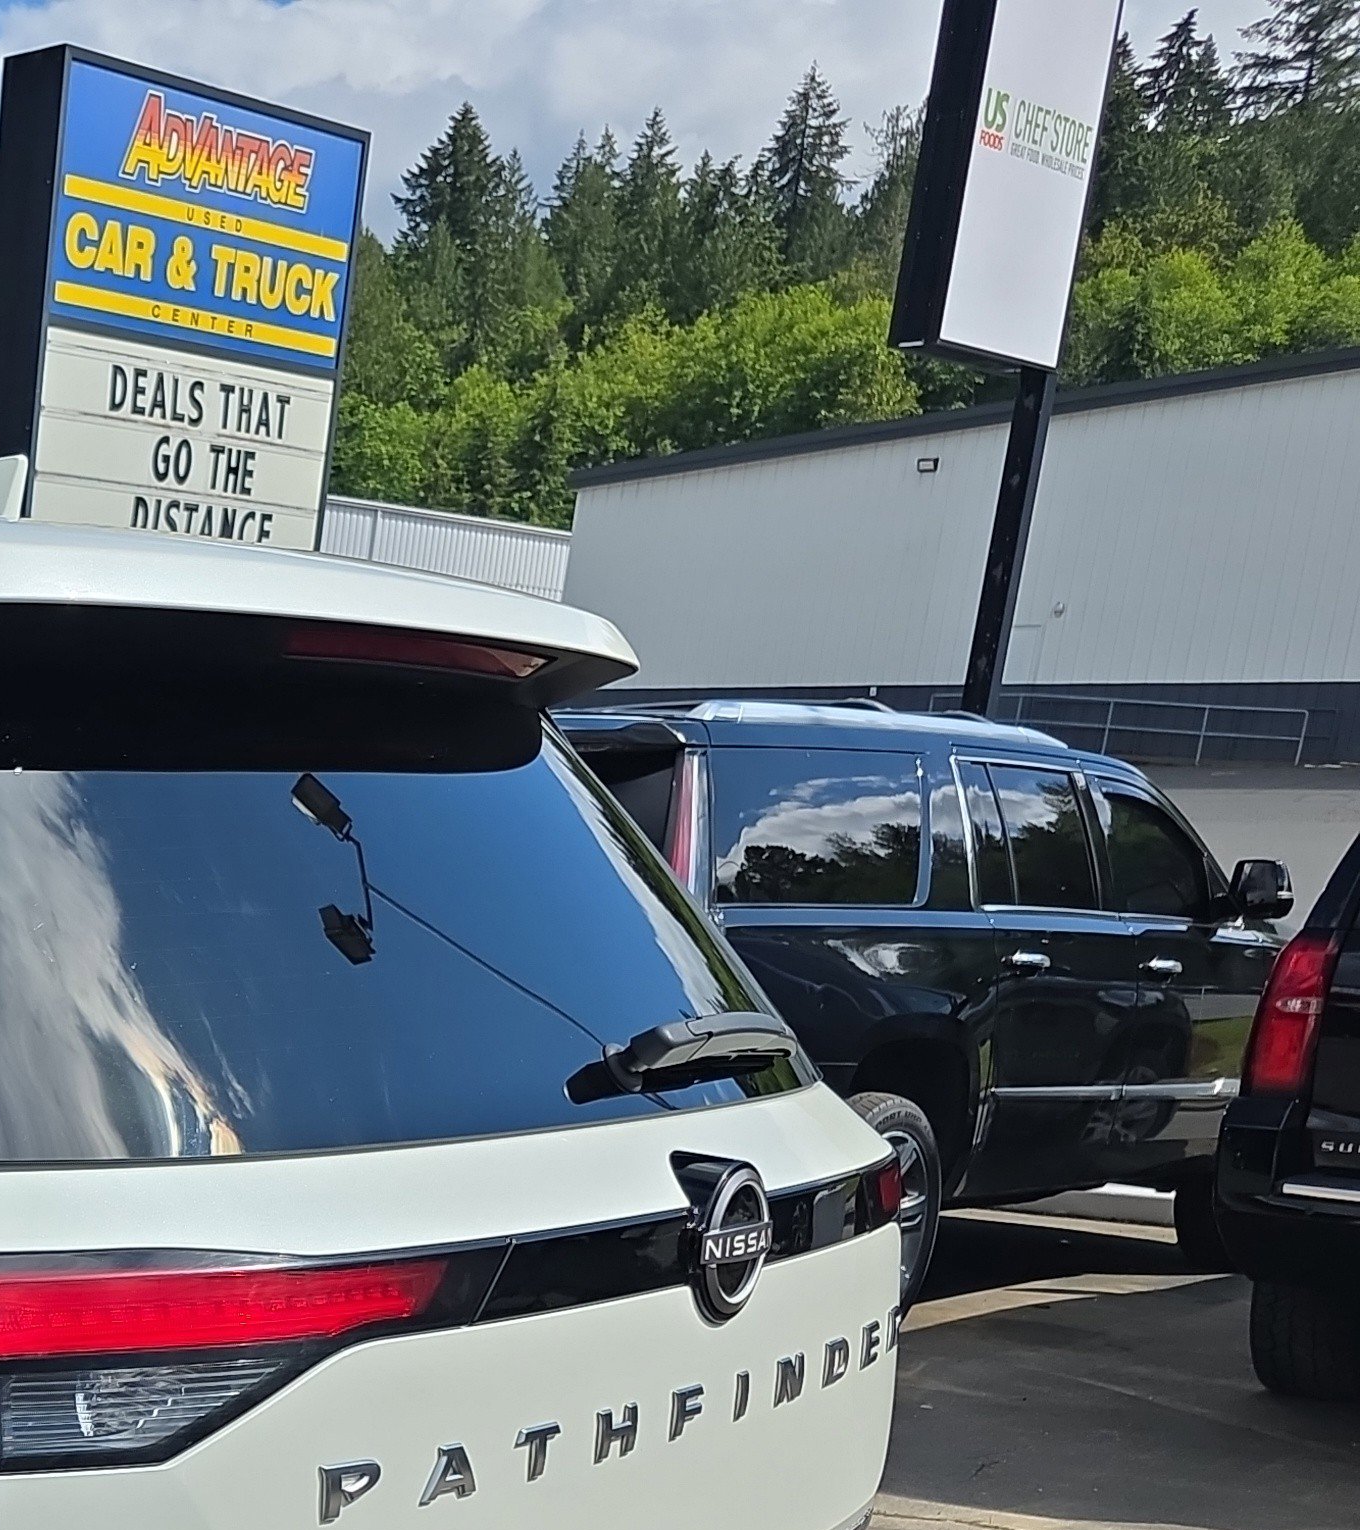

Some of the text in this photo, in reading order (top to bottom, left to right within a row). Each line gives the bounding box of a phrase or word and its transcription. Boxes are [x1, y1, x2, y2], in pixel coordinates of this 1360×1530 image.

[984, 87, 1010, 133] US
[122, 91, 314, 211] ADVANTAGE
[980, 129, 1003, 152] FOODS
[185, 207, 244, 235] USED
[65, 211, 340, 322] CAR & TRUCK
[150, 304, 255, 339] CENTER
[109, 364, 291, 440] DEALS THAT
[152, 435, 256, 497] GO THE
[130, 496, 273, 543] DISTANCE
[1321, 1141, 1360, 1154] SU
[704, 1227, 772, 1260] NISSAN
